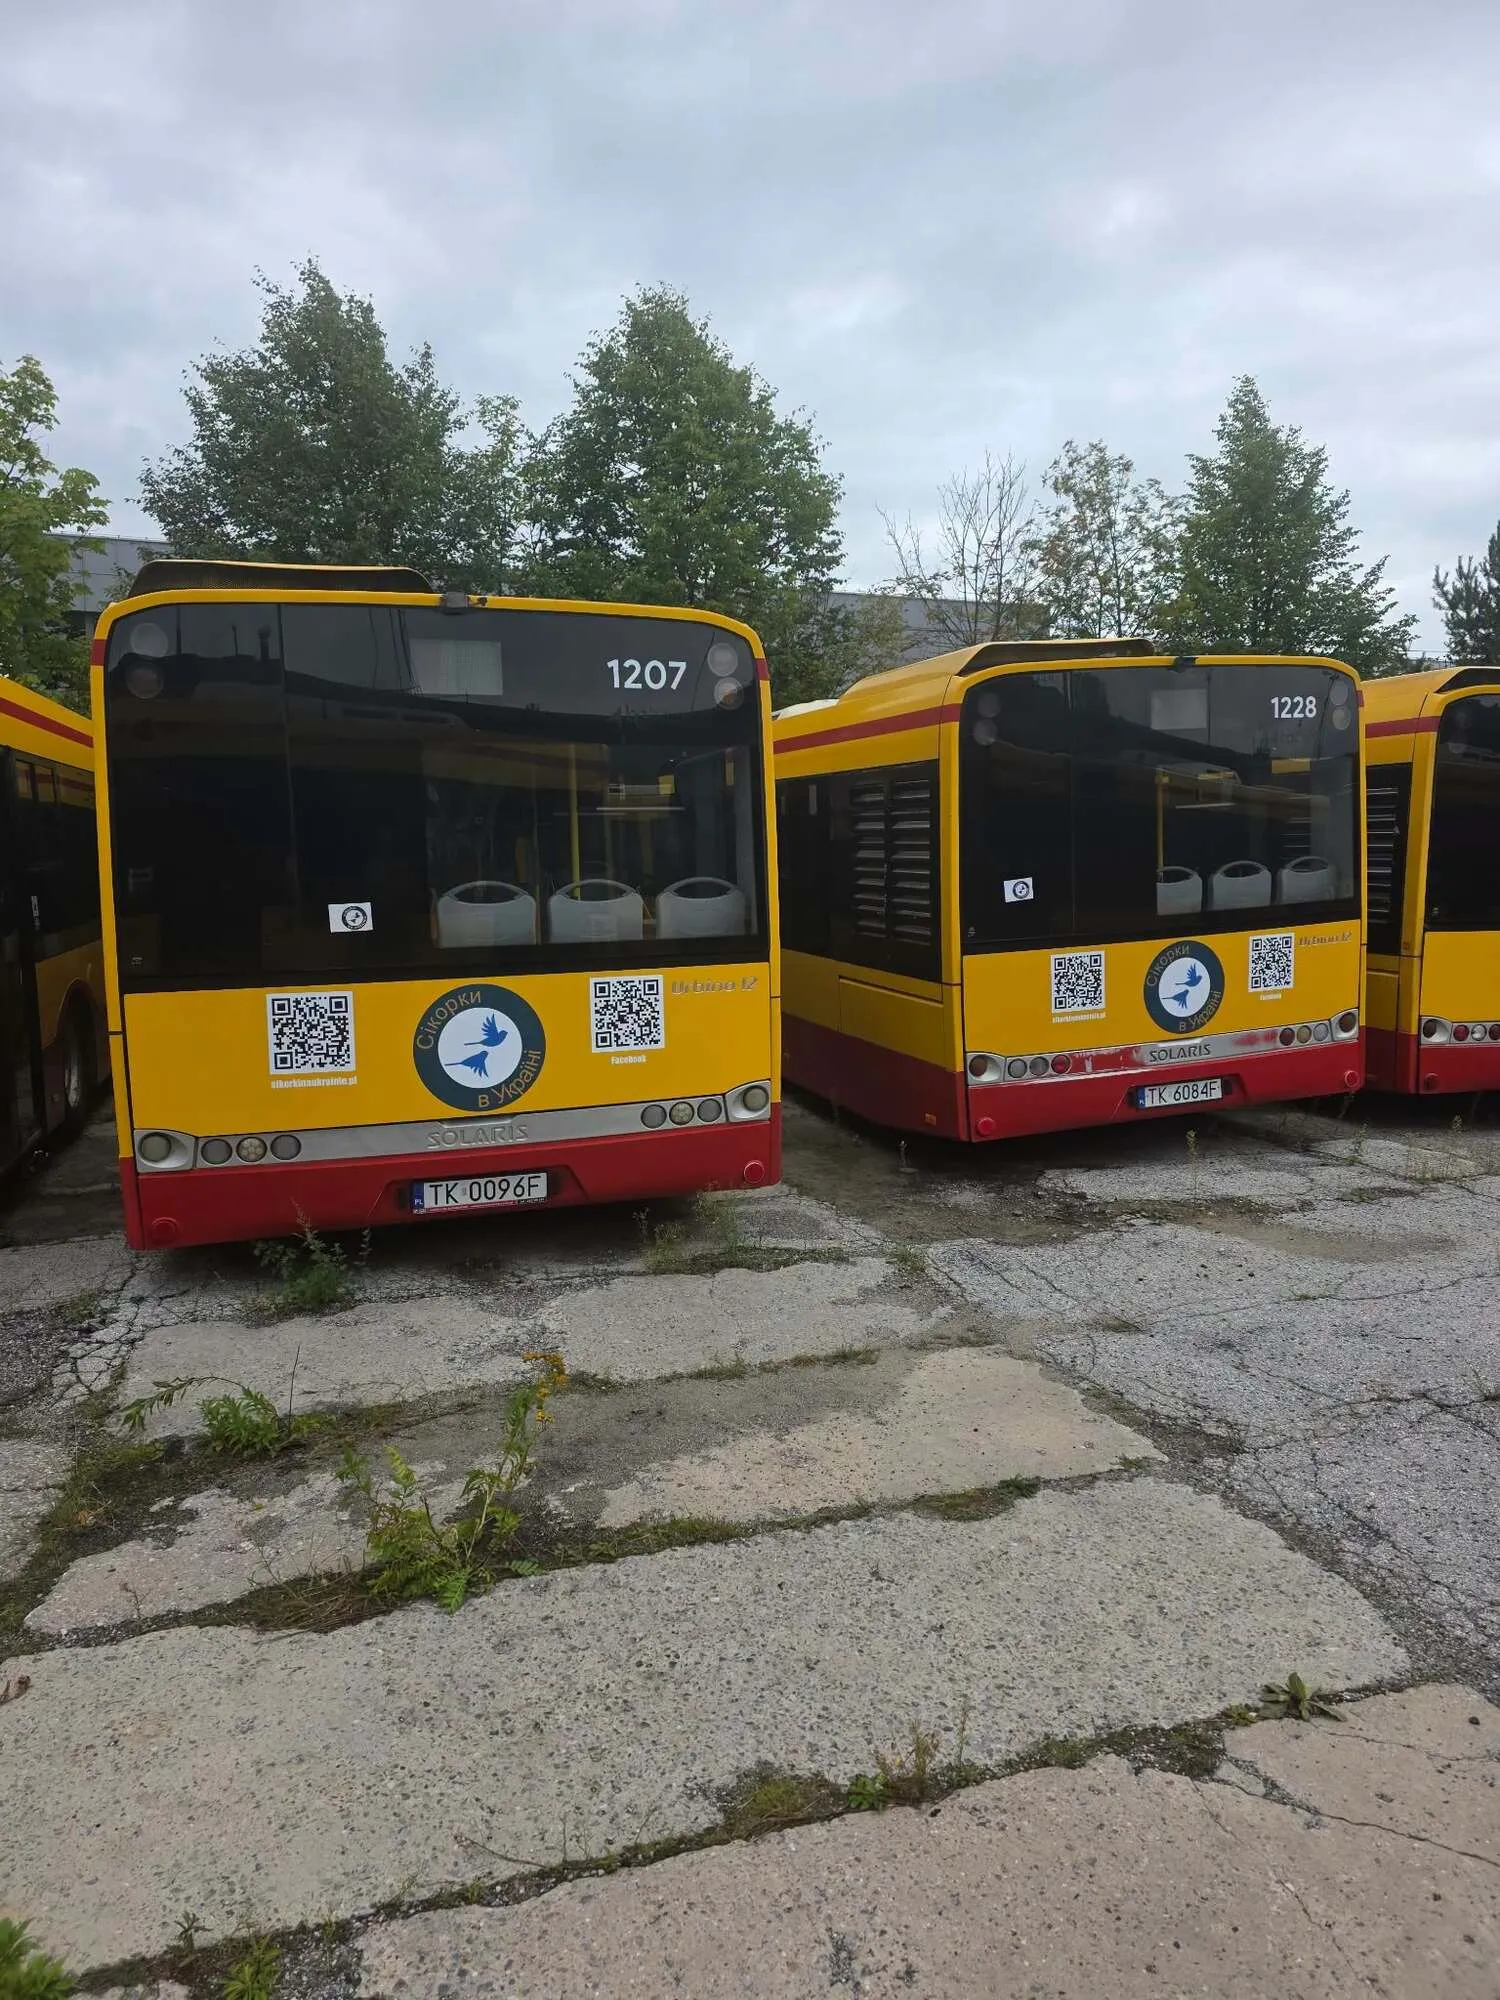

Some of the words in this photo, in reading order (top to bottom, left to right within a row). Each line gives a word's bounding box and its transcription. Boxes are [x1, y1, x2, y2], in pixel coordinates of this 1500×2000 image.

[607, 659, 687, 690] 1207
[1270, 695, 1317, 718] 1228
[1146, 944, 1190, 987] Сікорки
[671, 980, 737, 995] Urbino
[416, 990, 482, 1050] Сікорки
[1179, 1021, 1187, 1032] в
[1187, 990, 1222, 1029] Україні
[1149, 1043, 1212, 1063] SOLARIS
[477, 1094, 490, 1108] в
[491, 1049, 542, 1105] Україні
[1148, 1087, 1168, 1105] TK
[1173, 1080, 1218, 1102] 6084F
[426, 1124, 529, 1149] SOLARIS
[414, 1198, 424, 1206] PL
[429, 1182, 459, 1205] TK
[469, 1175, 542, 1202] 0096F
